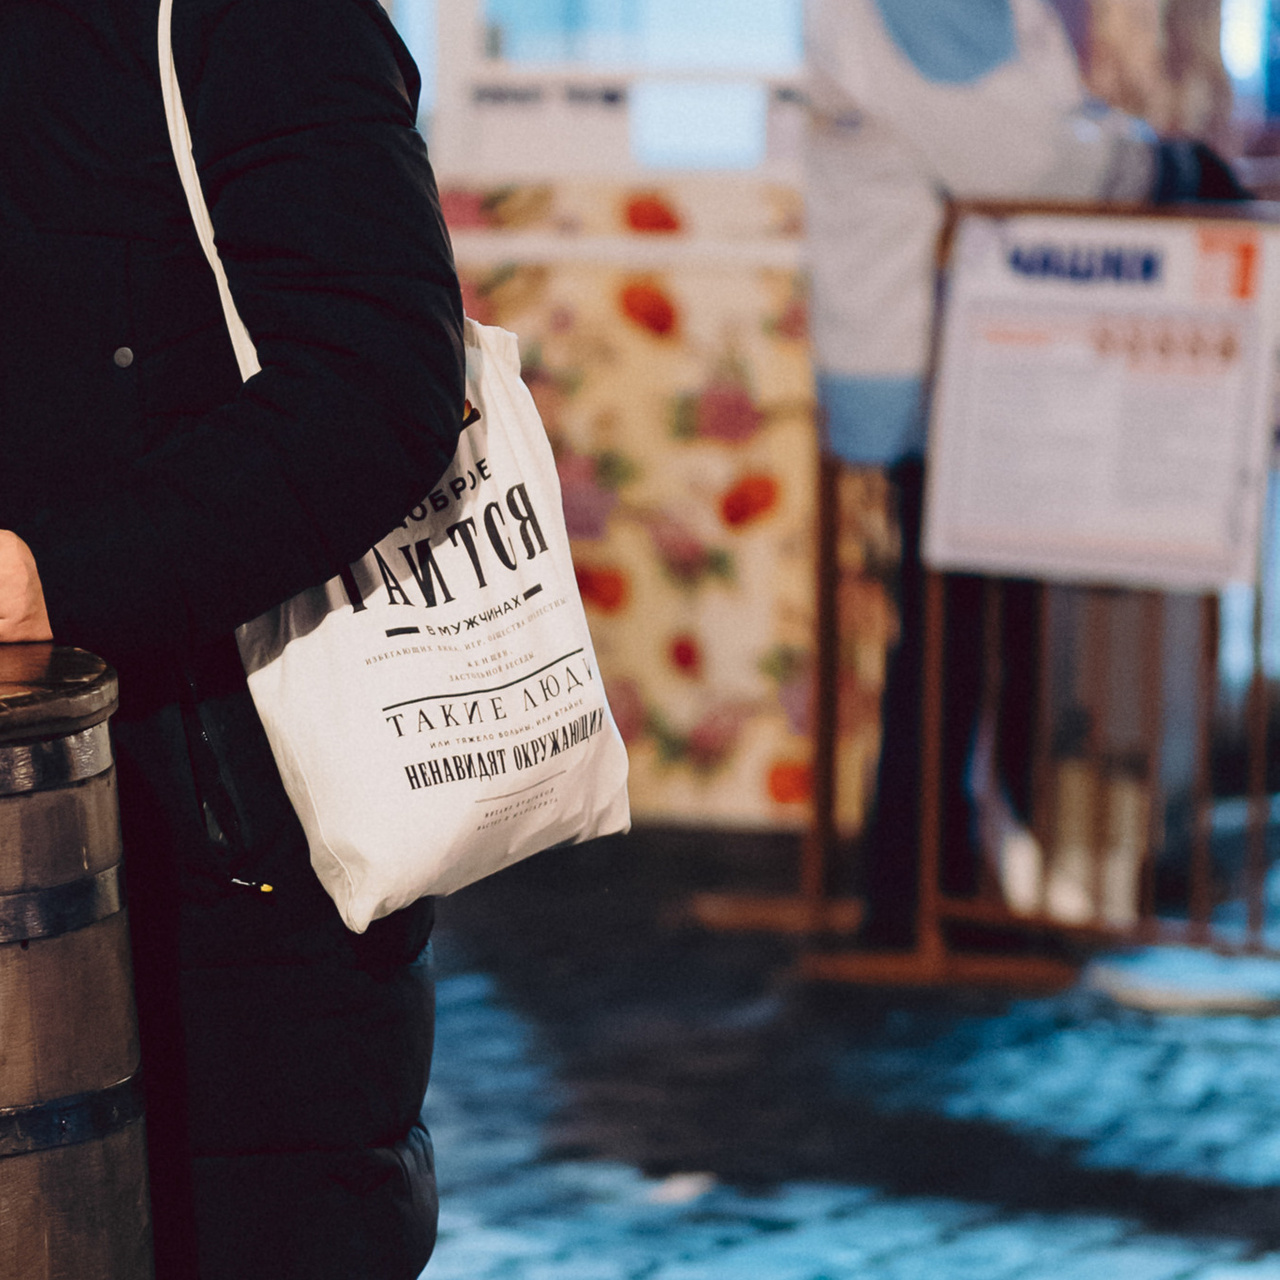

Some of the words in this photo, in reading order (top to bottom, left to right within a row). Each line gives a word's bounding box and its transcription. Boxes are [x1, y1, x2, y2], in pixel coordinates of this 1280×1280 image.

[438, 595, 522, 636] МУЖЧИНАХ
[386, 696, 507, 738] ТАКИЕ
[430, 739, 450, 749] ИЛИ
[456, 733, 495, 745] ТЯЖЕЛО
[536, 714, 552, 726] ИЛИ
[404, 748, 506, 790] НЕНАВИДЯТ
